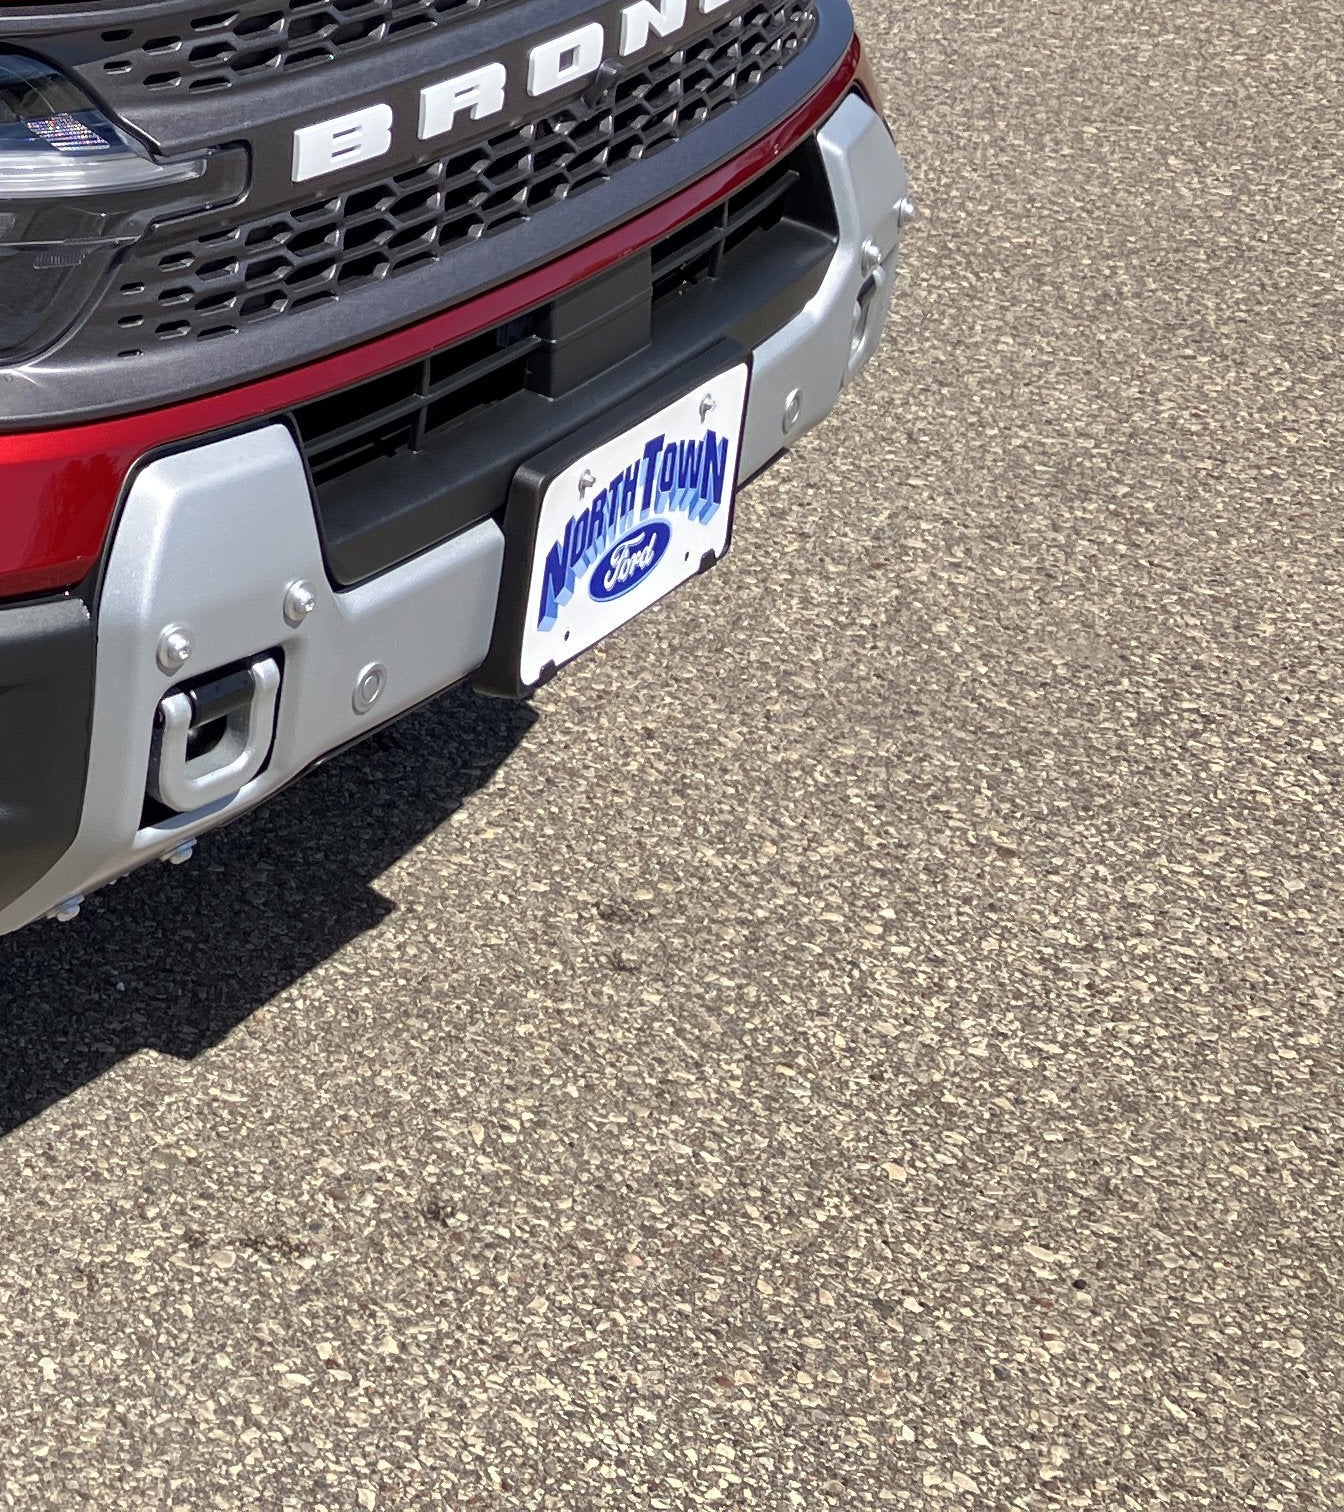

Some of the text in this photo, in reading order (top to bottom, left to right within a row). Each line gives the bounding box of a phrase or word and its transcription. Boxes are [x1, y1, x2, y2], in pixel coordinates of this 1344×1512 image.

[537, 429, 729, 631] NORTH TOWN
[603, 531, 658, 592] Ford
